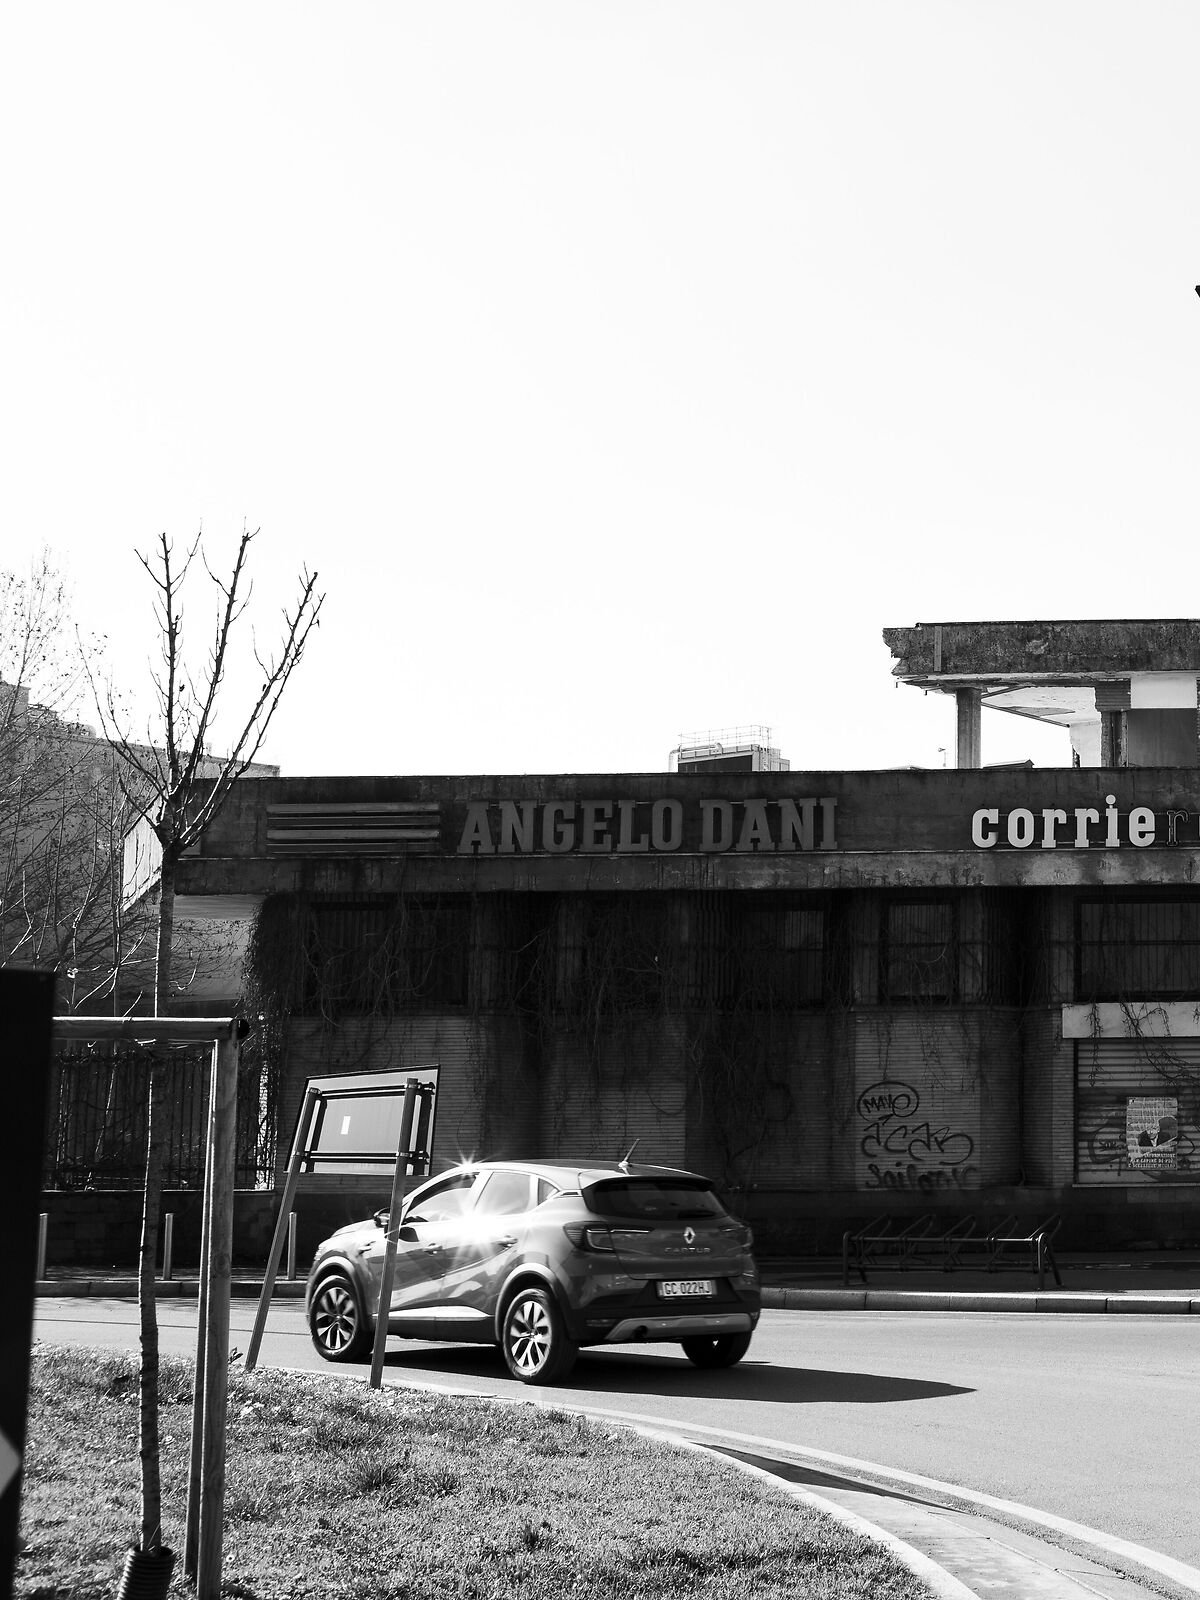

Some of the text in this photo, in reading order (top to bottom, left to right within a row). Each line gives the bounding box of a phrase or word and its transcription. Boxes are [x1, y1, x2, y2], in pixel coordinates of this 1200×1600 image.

[457, 796, 838, 855] ANGELO DANI
[665, 1283, 677, 1295] GC
